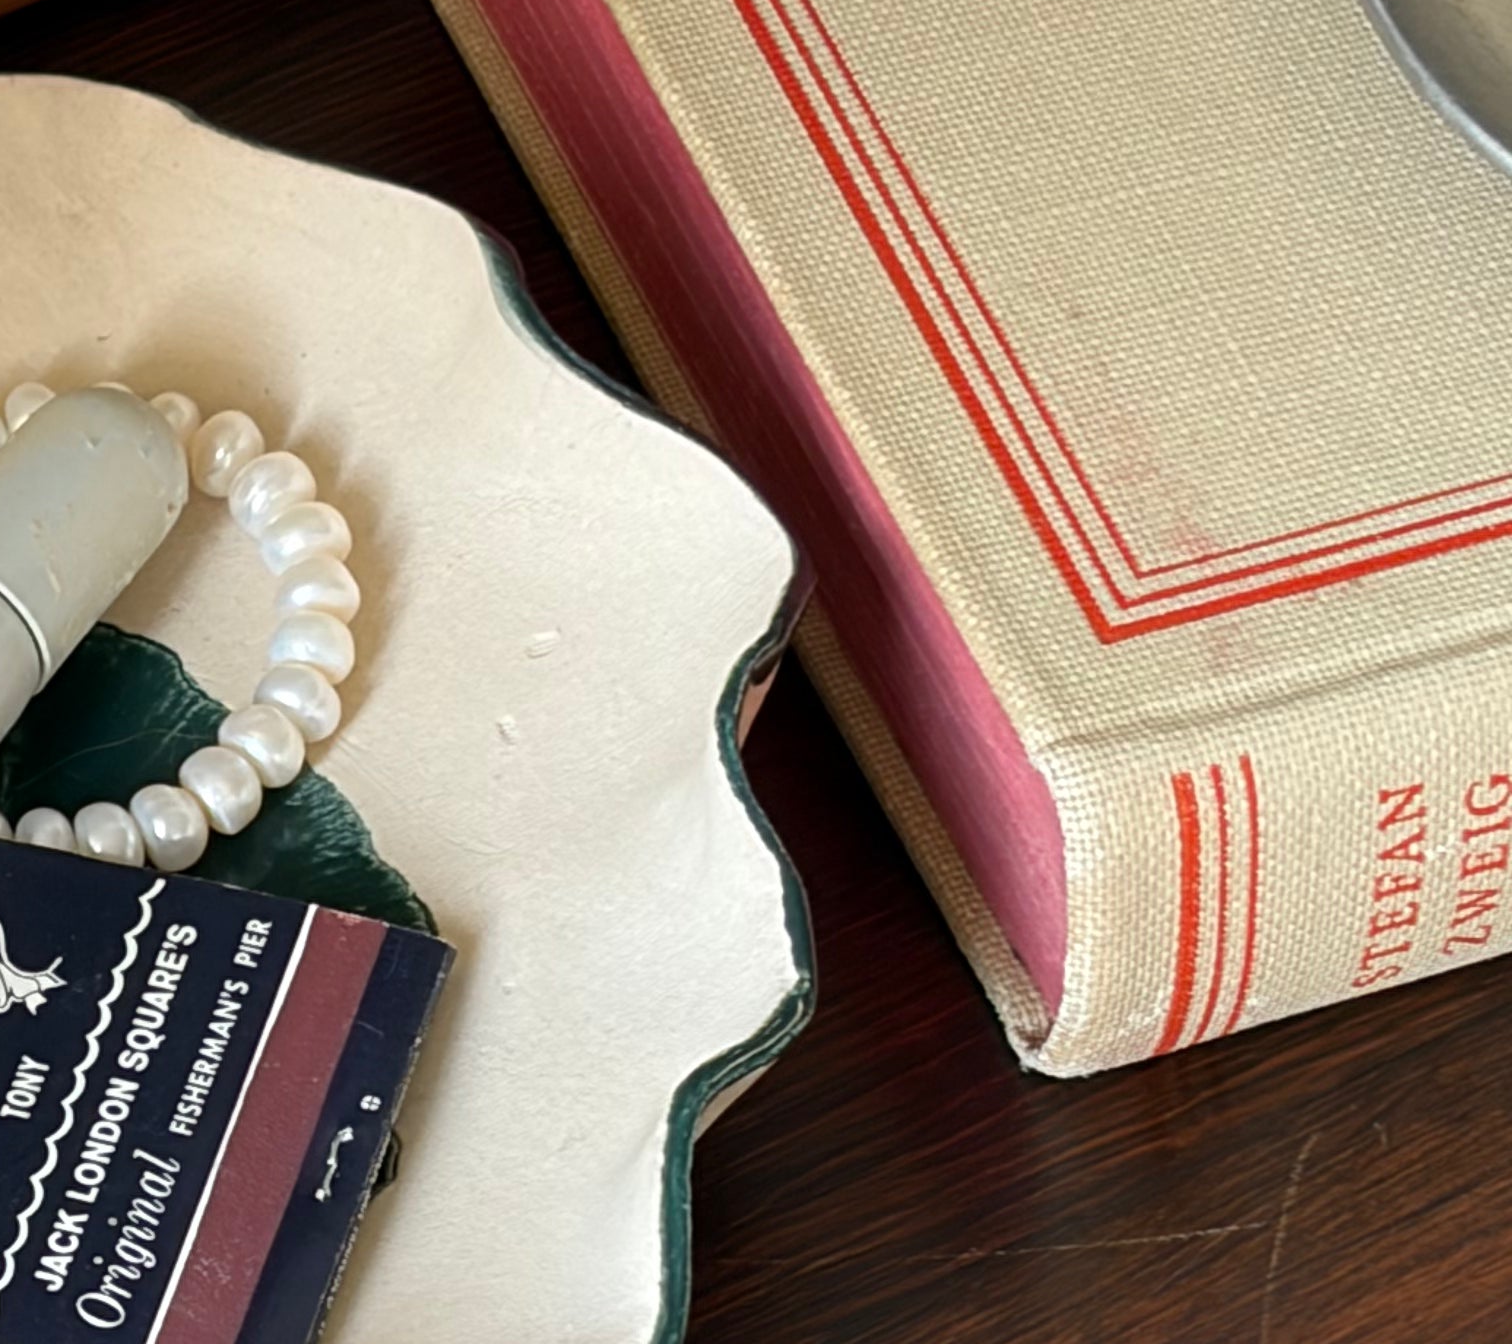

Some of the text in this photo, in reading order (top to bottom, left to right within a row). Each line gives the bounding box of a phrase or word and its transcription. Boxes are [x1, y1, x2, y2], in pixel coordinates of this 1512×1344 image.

[1352, 782, 1428, 988] STEFAN
[1442, 773, 1512, 956] ZWEIG
[0, 1055, 50, 1119] TONY
[34, 923, 198, 1292] JACK LONDON SQUARE'S
[76, 918, 273, 1329] Original FISHERMAN'S PIER
